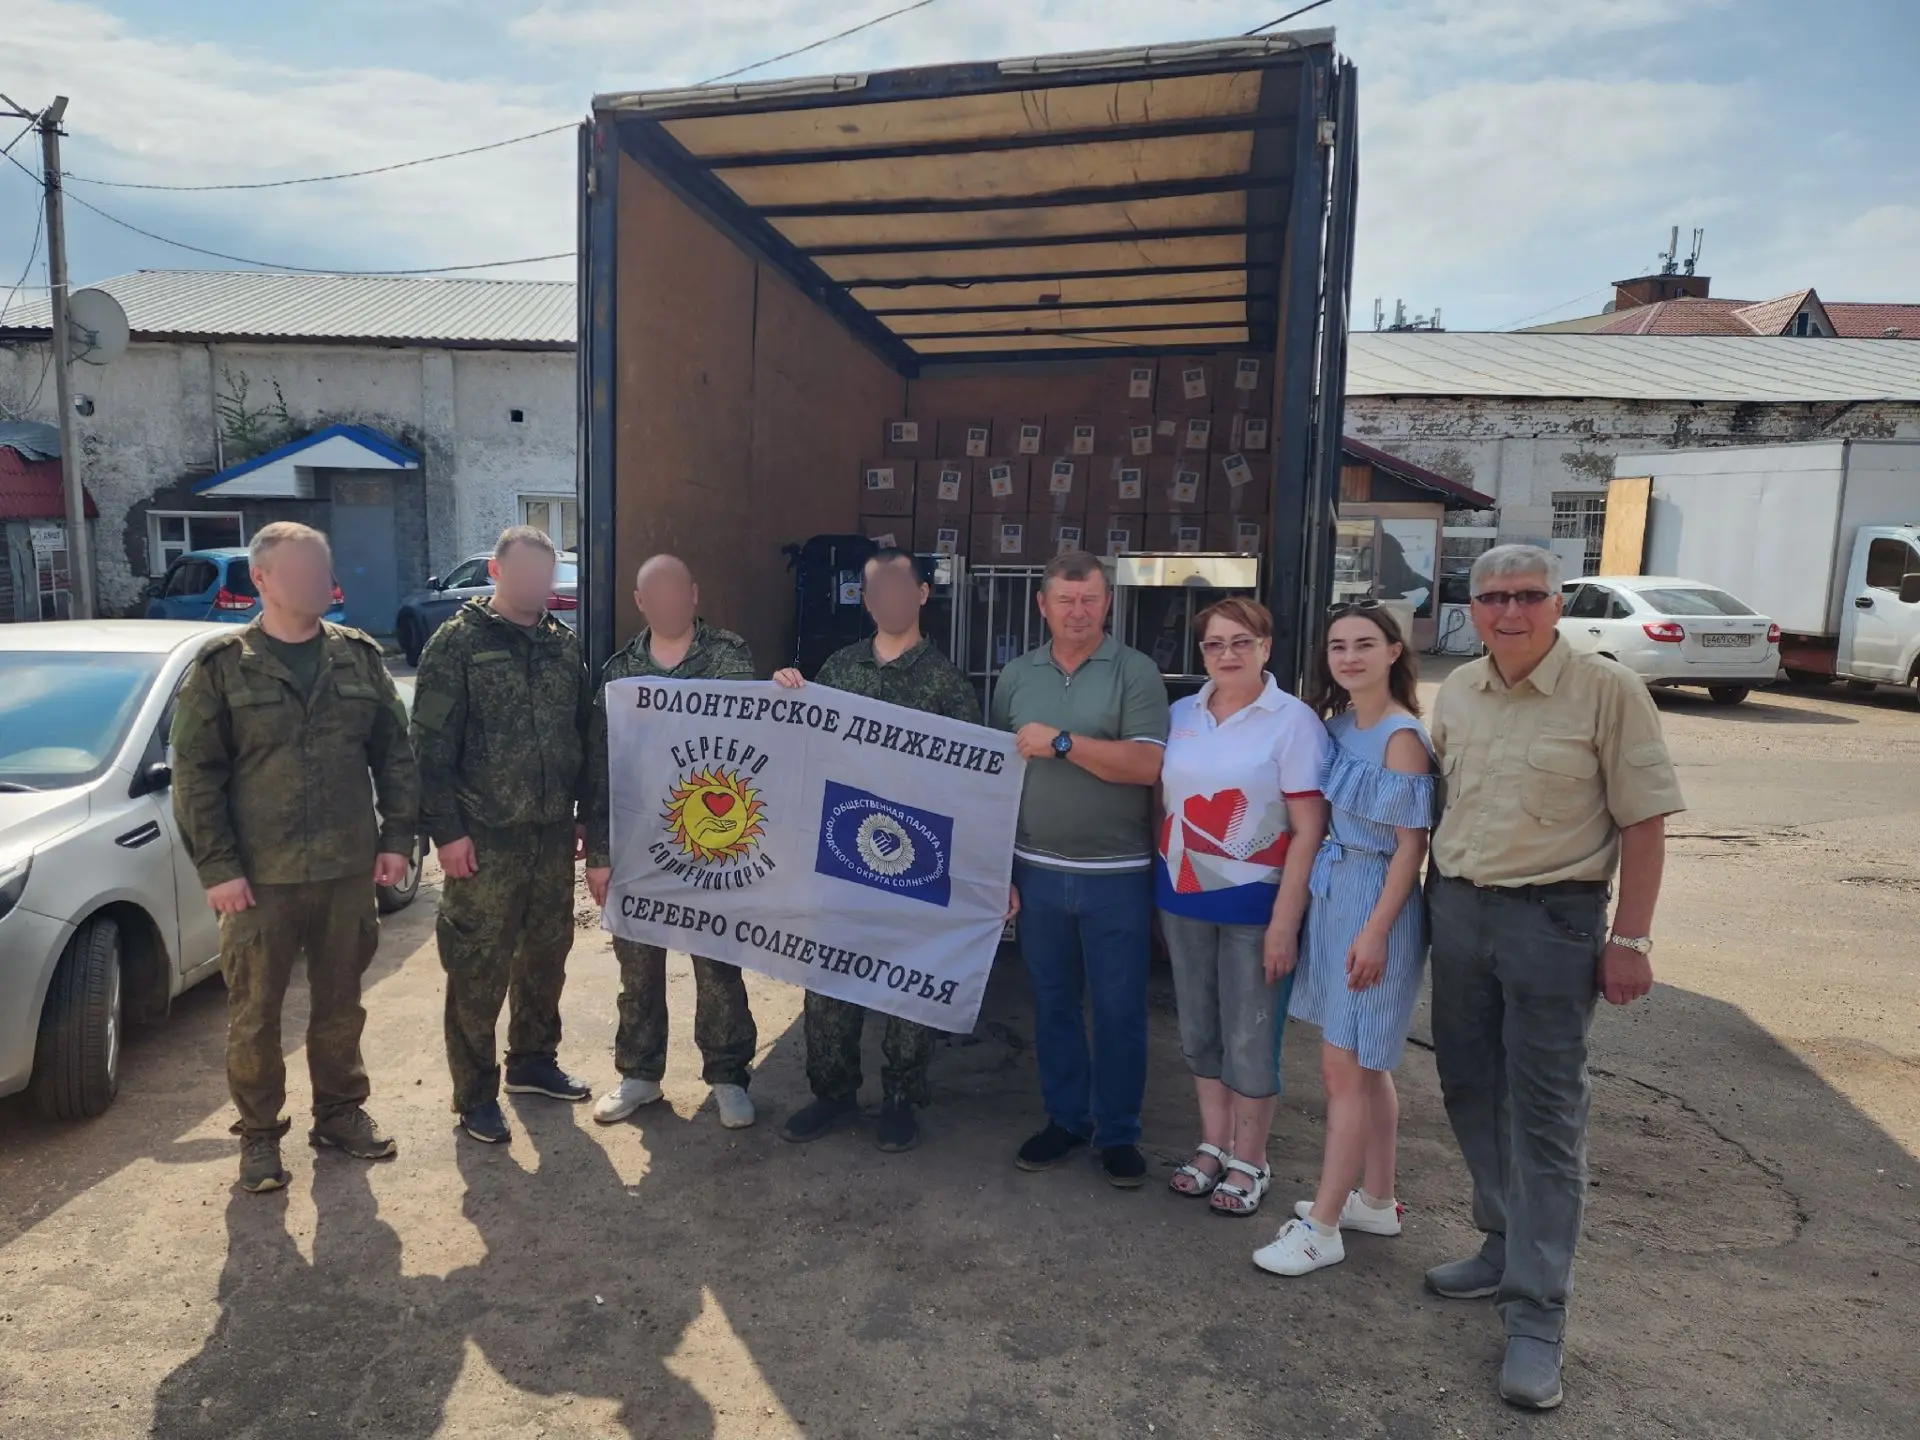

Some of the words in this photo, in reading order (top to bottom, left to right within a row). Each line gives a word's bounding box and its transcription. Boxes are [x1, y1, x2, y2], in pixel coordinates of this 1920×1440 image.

[636, 686, 840, 733] ВОЛОНТЕРСКОЕ
[843, 715, 1005, 775] ДВИЖЕНИЕ
[671, 736, 769, 774] СЕРЕБРО
[826, 817, 854, 869] ГОРОДСКОГО
[856, 866, 891, 885] ОКРУГА
[833, 799, 905, 820] ОБЩЕСТВЕННАЯ
[905, 815, 940, 849] ПАЛАТА
[648, 841, 776, 890] СОЛНЕЧНОГОРЬЯ
[621, 895, 727, 936] СЕРЕБРО
[735, 921, 959, 1005] СОЛНЕЧНОГОРЬЯ
